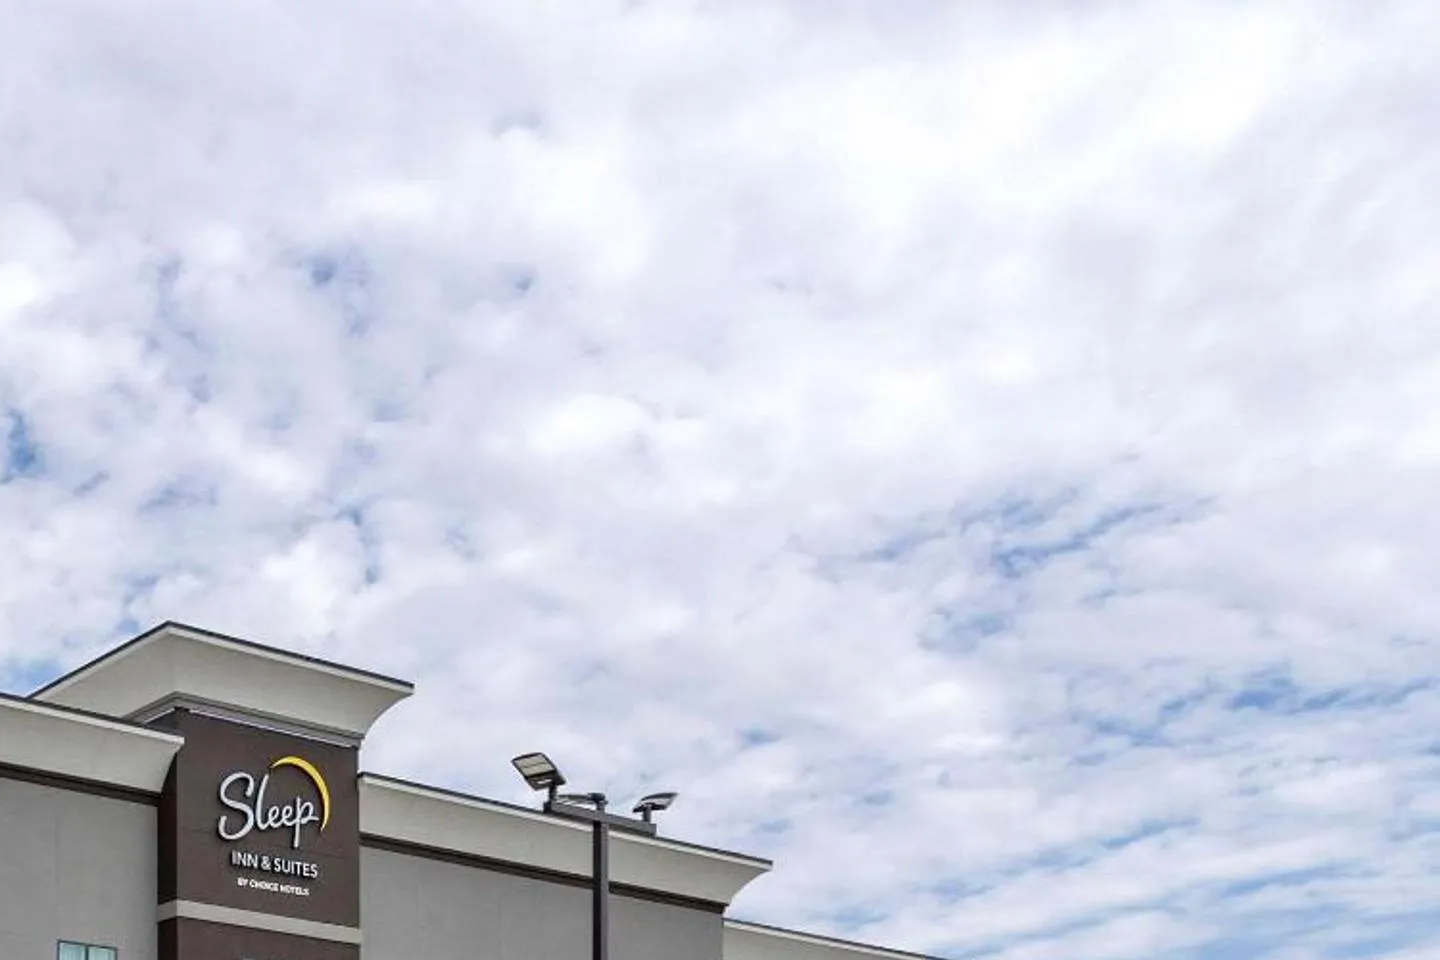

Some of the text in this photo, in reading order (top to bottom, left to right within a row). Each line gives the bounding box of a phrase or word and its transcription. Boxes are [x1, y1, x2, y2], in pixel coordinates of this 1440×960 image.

[218, 771, 320, 848] Sleep
[232, 850, 318, 878] INN & SUITES
